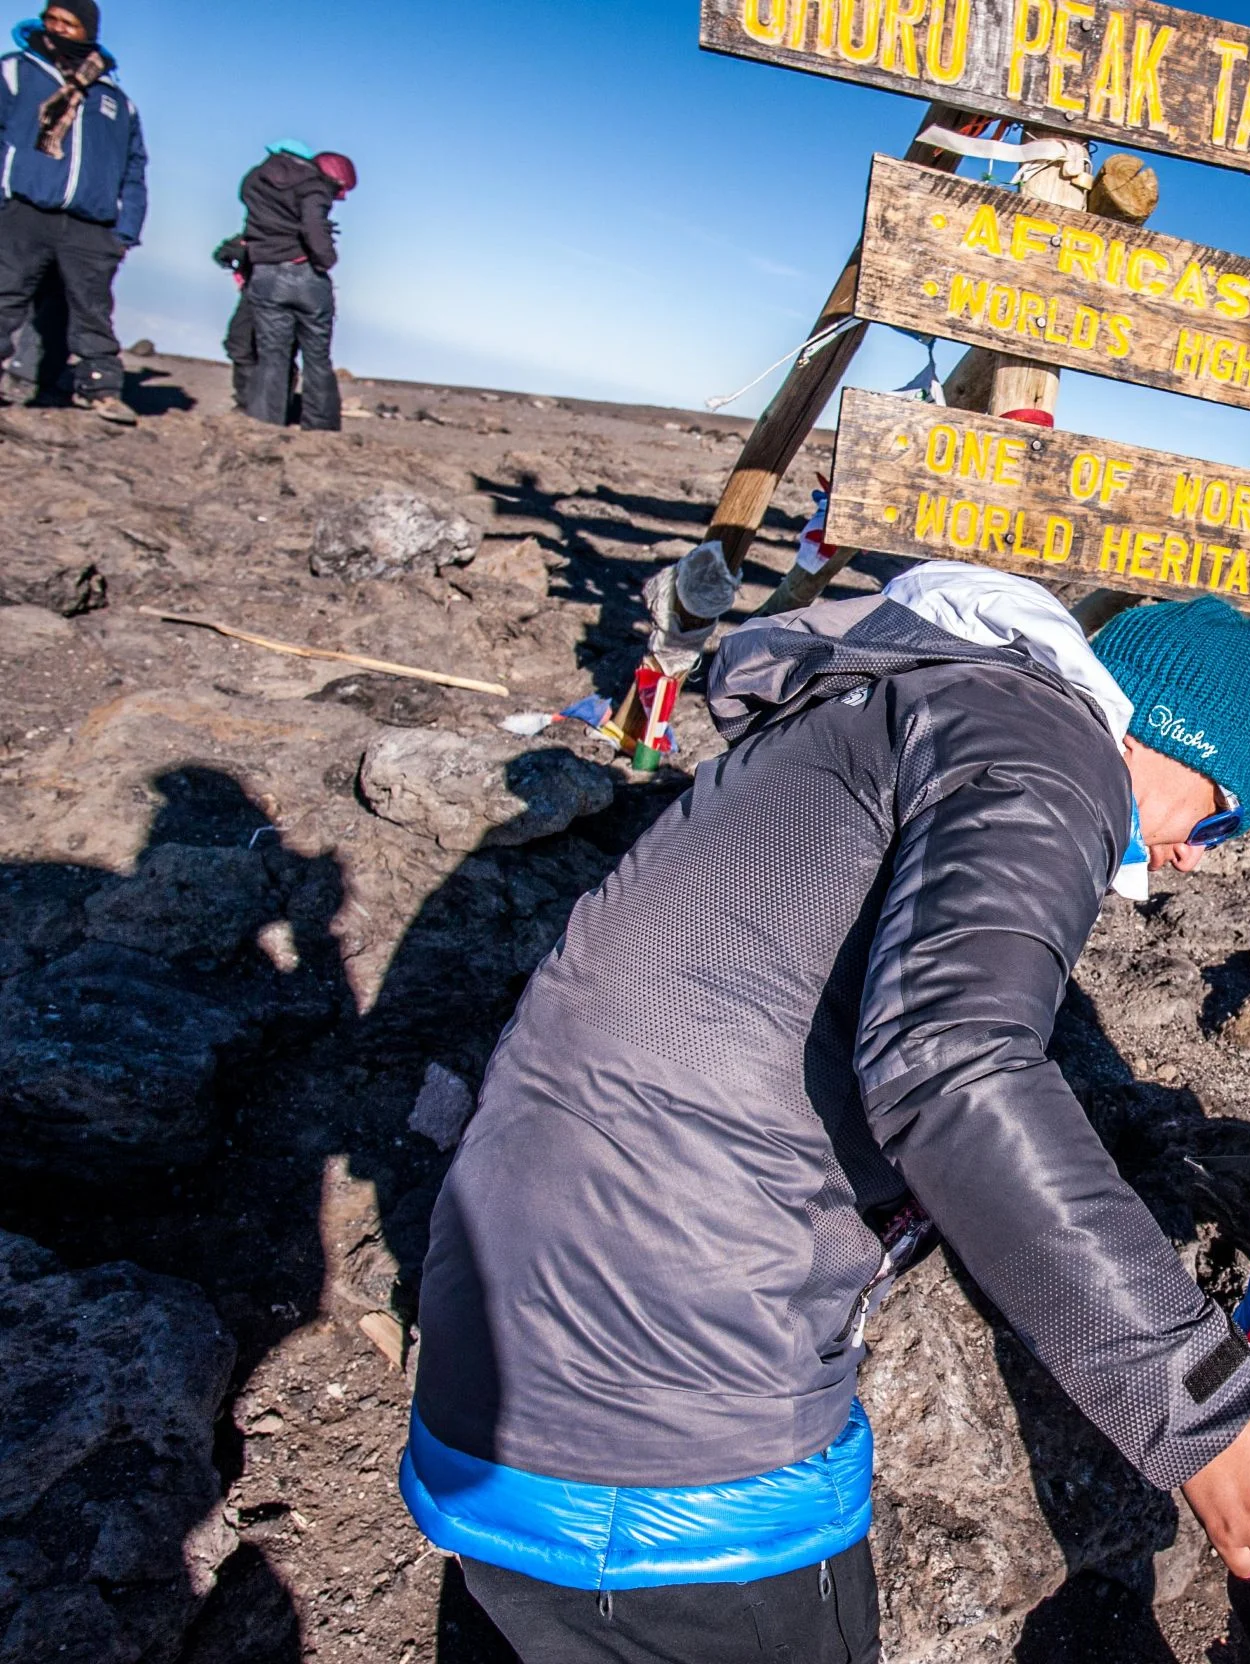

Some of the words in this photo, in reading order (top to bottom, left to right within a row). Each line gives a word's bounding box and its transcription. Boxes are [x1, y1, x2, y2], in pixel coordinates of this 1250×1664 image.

[946, 273, 1134, 358] WORLD'S
[925, 423, 1027, 487] ONE
[1070, 452, 1134, 504] OF
[914, 492, 1075, 564] WORLD
